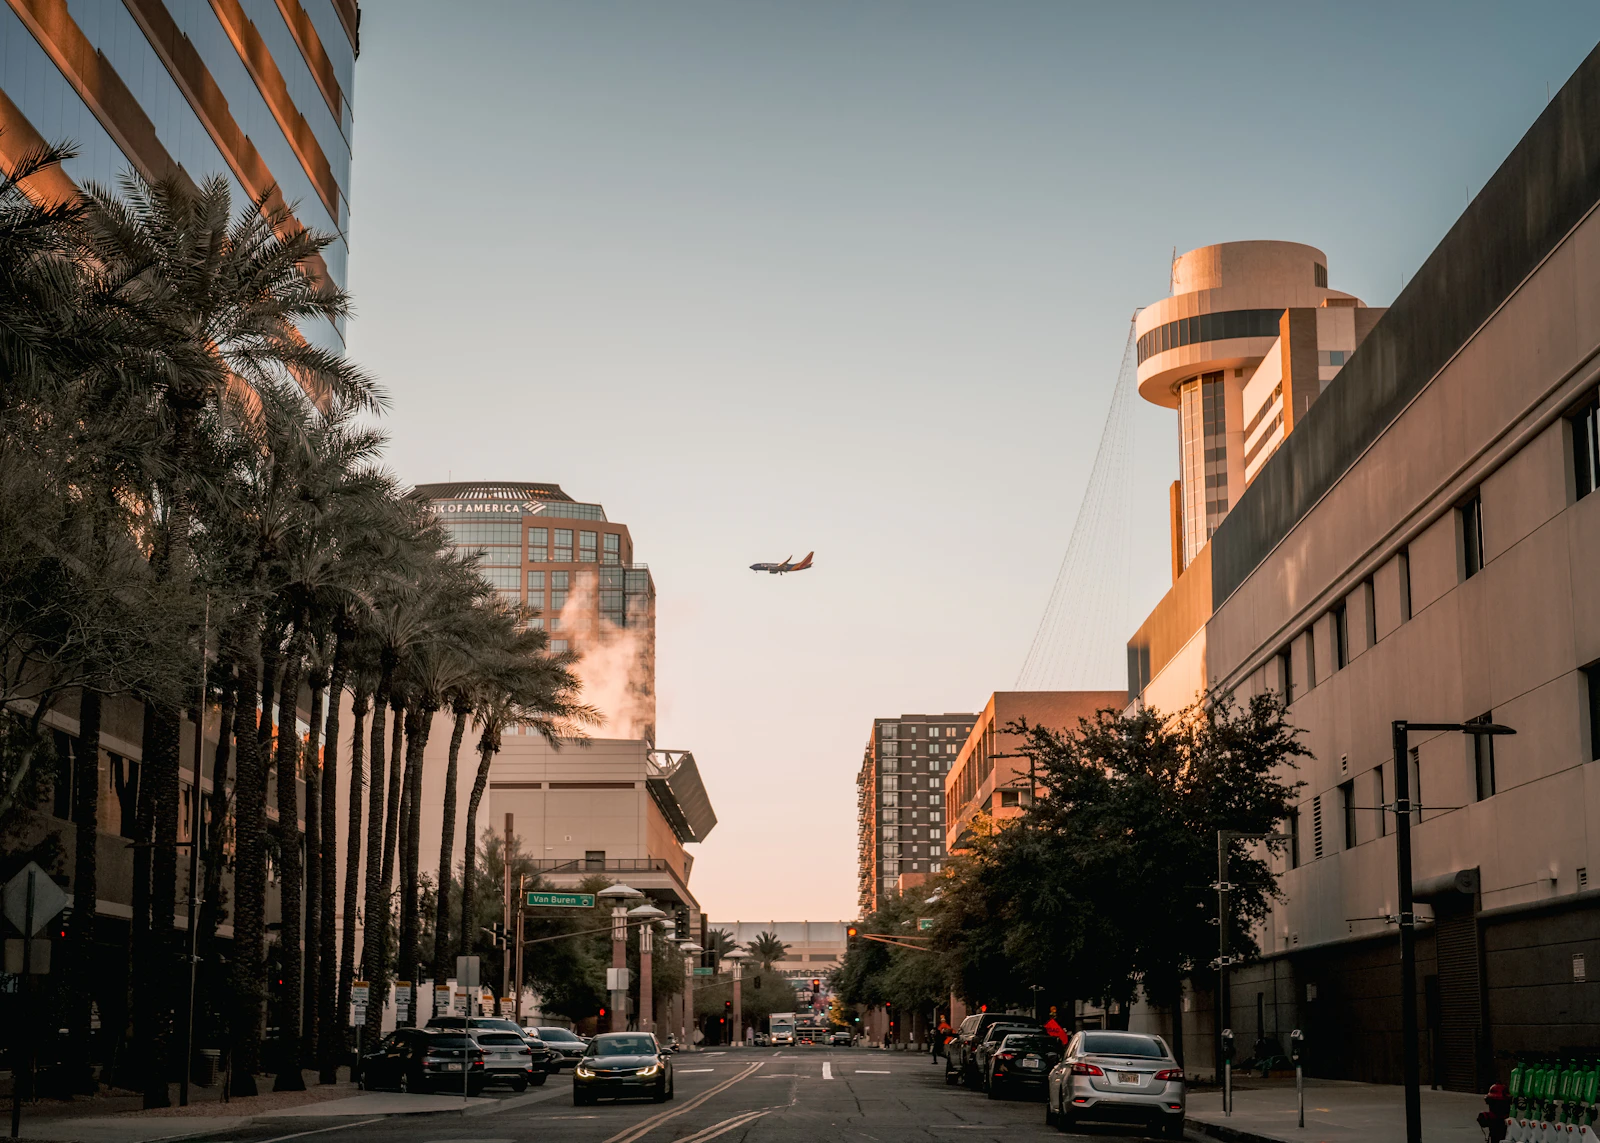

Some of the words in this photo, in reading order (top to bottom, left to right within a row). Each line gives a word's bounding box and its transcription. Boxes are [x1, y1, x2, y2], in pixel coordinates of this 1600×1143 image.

[447, 504, 463, 513] OF
[465, 504, 520, 513] AMERICA
[533, 895, 549, 903] Van
[551, 895, 576, 904] Buren
